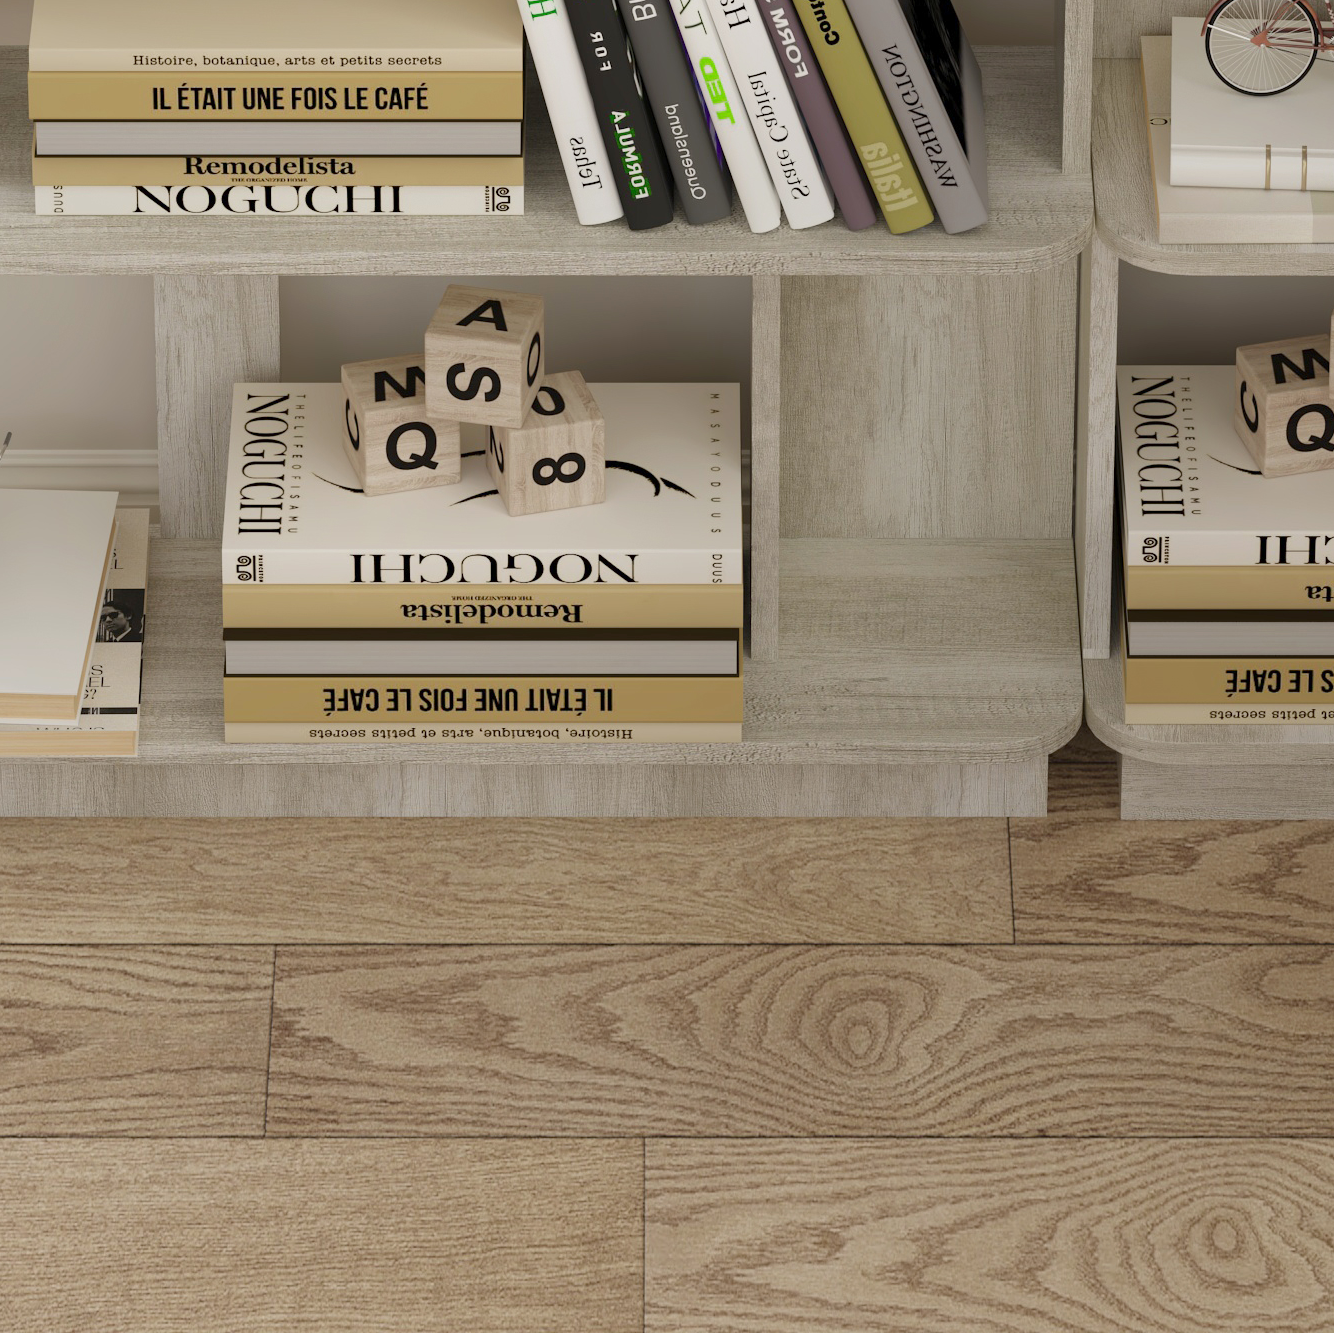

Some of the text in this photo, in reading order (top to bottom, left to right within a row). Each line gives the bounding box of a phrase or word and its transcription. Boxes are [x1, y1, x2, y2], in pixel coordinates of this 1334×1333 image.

[132, 55, 442, 67] Histoire, botanique, arts et petits secrets
[152, 83, 429, 110] IL ÉTAIT UNE FOIS LE CAFÉ
[183, 157, 356, 176] Remodelista
[132, 186, 404, 213] NOGUCHI
[1130, 376, 1186, 517] NOGUCHI
[238, 393, 290, 535] NOGUCHI
[350, 553, 639, 584] NOGUCHI
[400, 604, 583, 623] Remodelista
